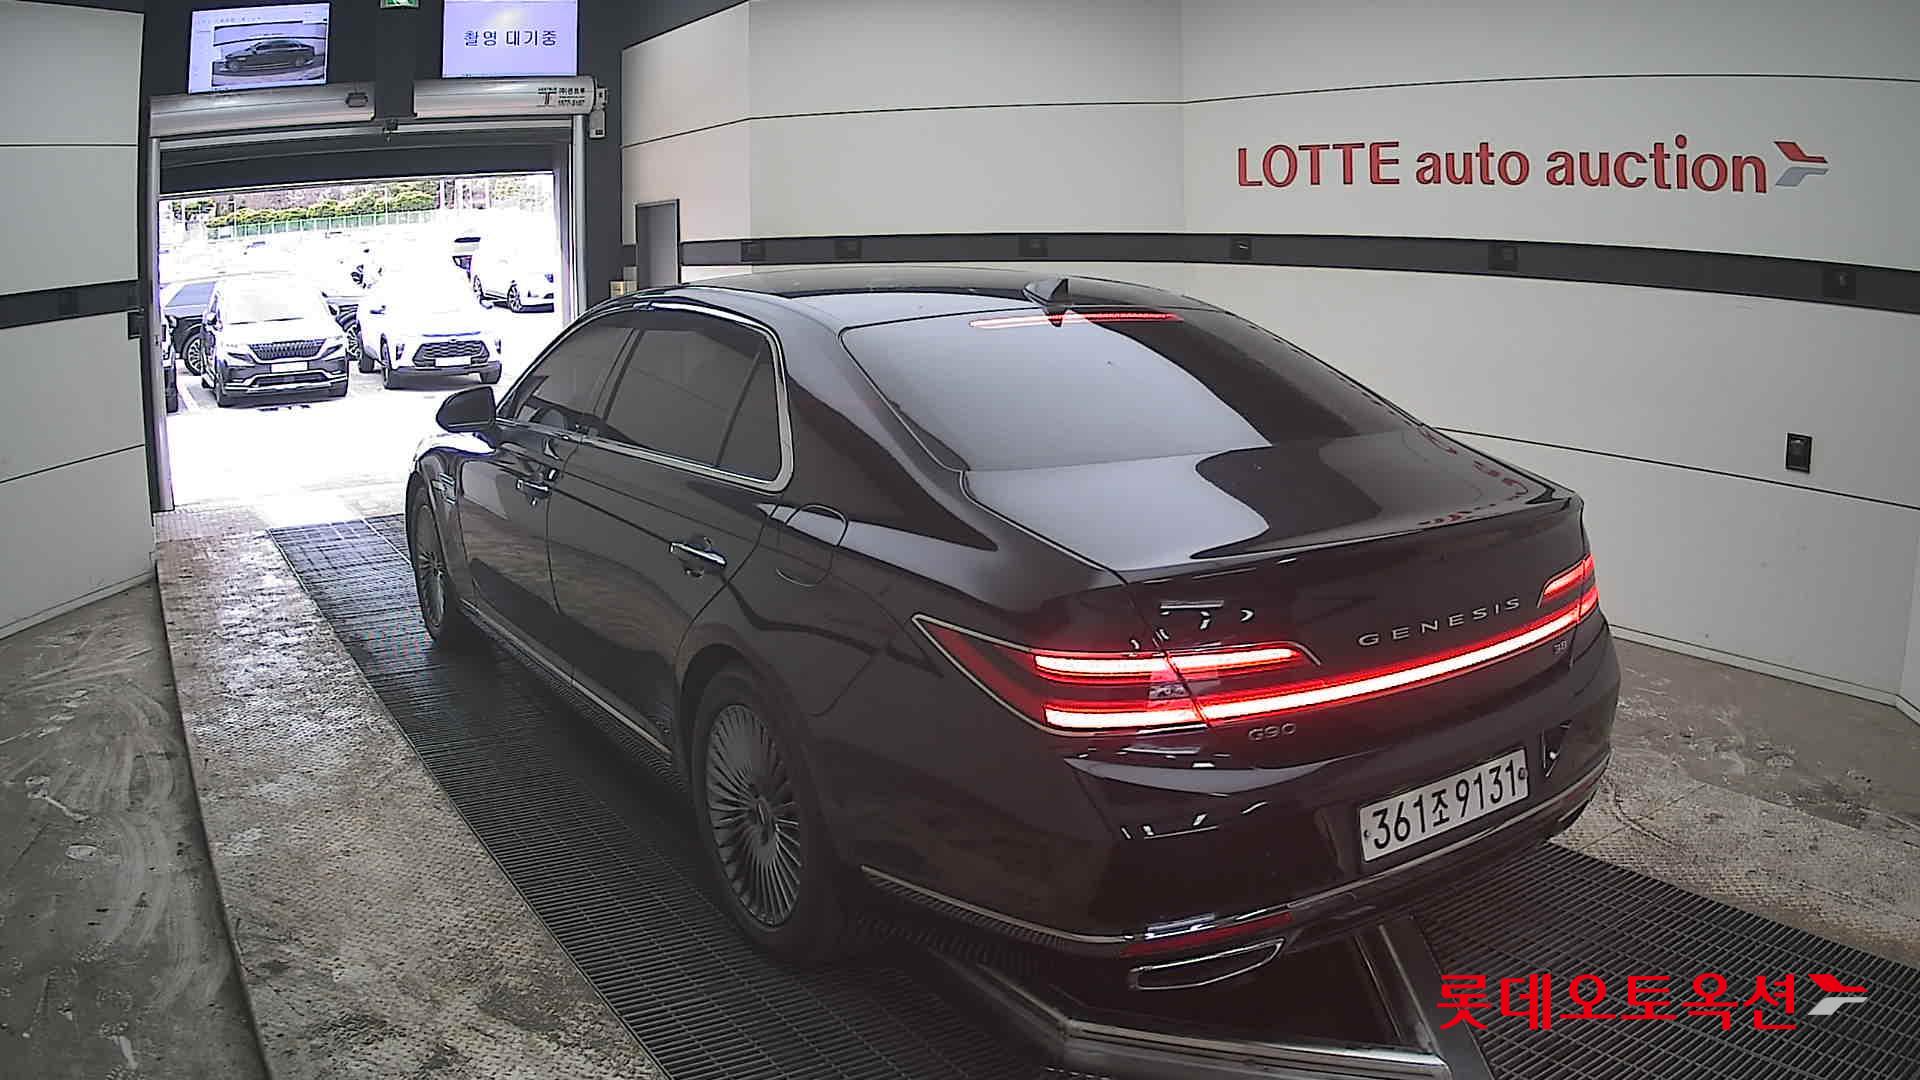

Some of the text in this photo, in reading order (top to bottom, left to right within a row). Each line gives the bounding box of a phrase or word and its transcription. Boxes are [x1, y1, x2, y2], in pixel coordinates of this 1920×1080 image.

[464, 30, 557, 47] 촬영 대기중
[1237, 134, 1768, 194] LOTTE auto auction
[1358, 598, 1520, 646] GENESIS
[1248, 722, 1296, 740] G90
